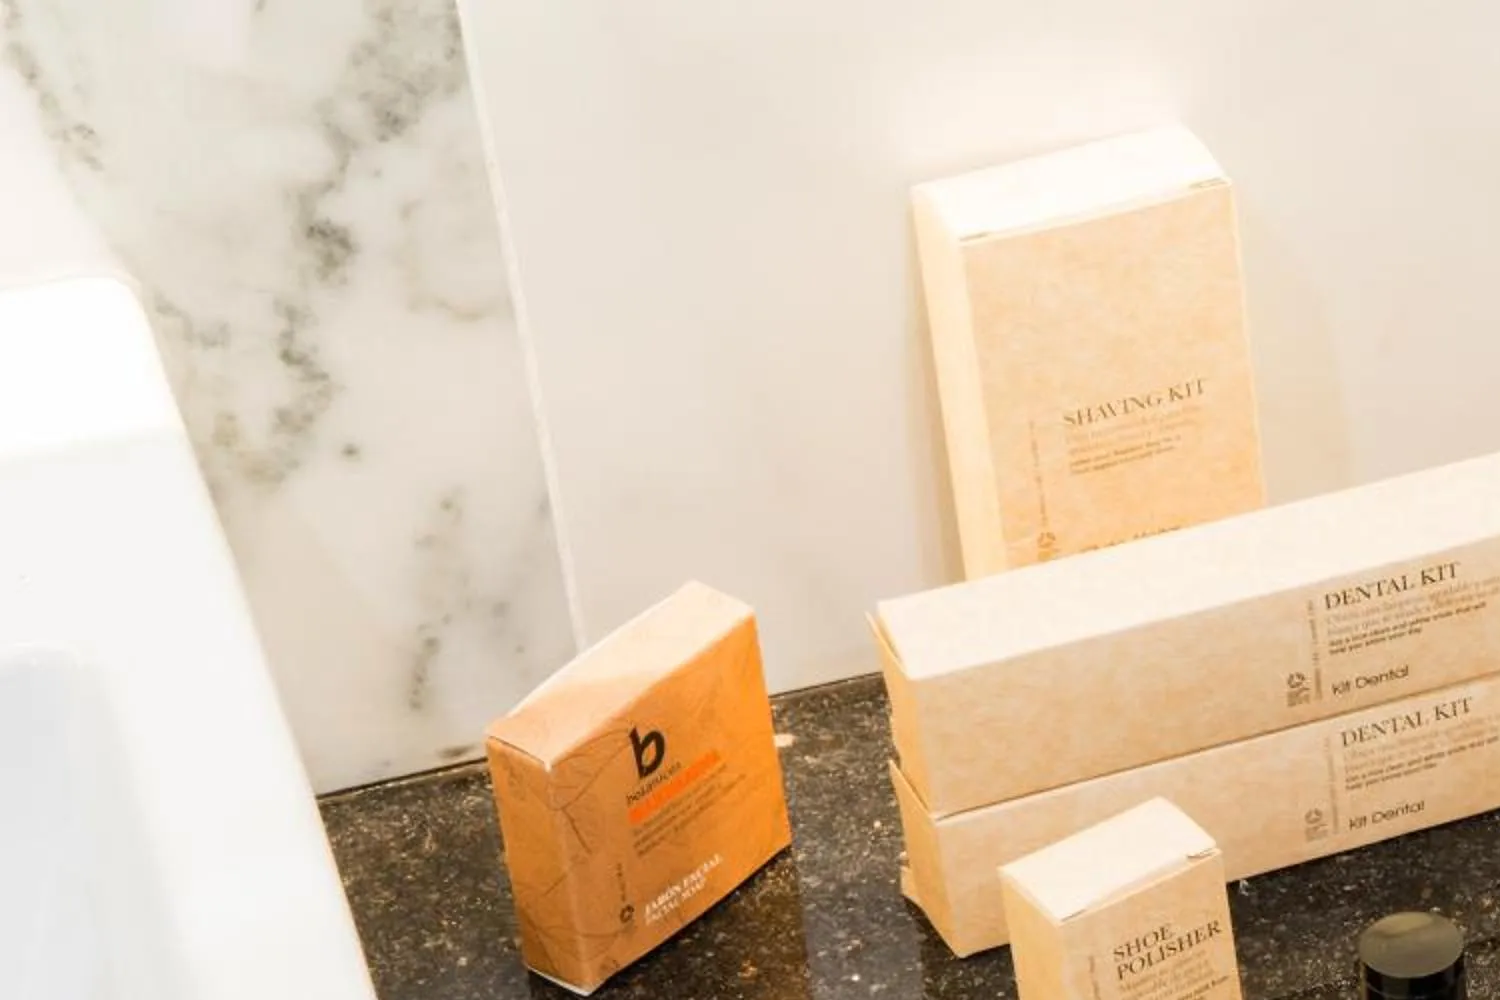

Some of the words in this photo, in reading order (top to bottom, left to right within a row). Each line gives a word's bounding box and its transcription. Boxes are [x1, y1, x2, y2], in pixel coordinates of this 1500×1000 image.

[1064, 394, 1161, 426] SHAVING
[1169, 378, 1207, 402] KIT
[1325, 575, 1414, 610] DENTAL
[1420, 562, 1460, 587] KIT
[1332, 680, 1350, 695] Kit
[1355, 665, 1409, 689] Dental
[1341, 712, 1429, 747] DENTAL
[1435, 697, 1472, 720] KIT
[1350, 816, 1367, 829] Kit
[1371, 801, 1425, 821] Dental
[1113, 924, 1176, 962] SHOE
[1117, 920, 1221, 979] POLISHER
